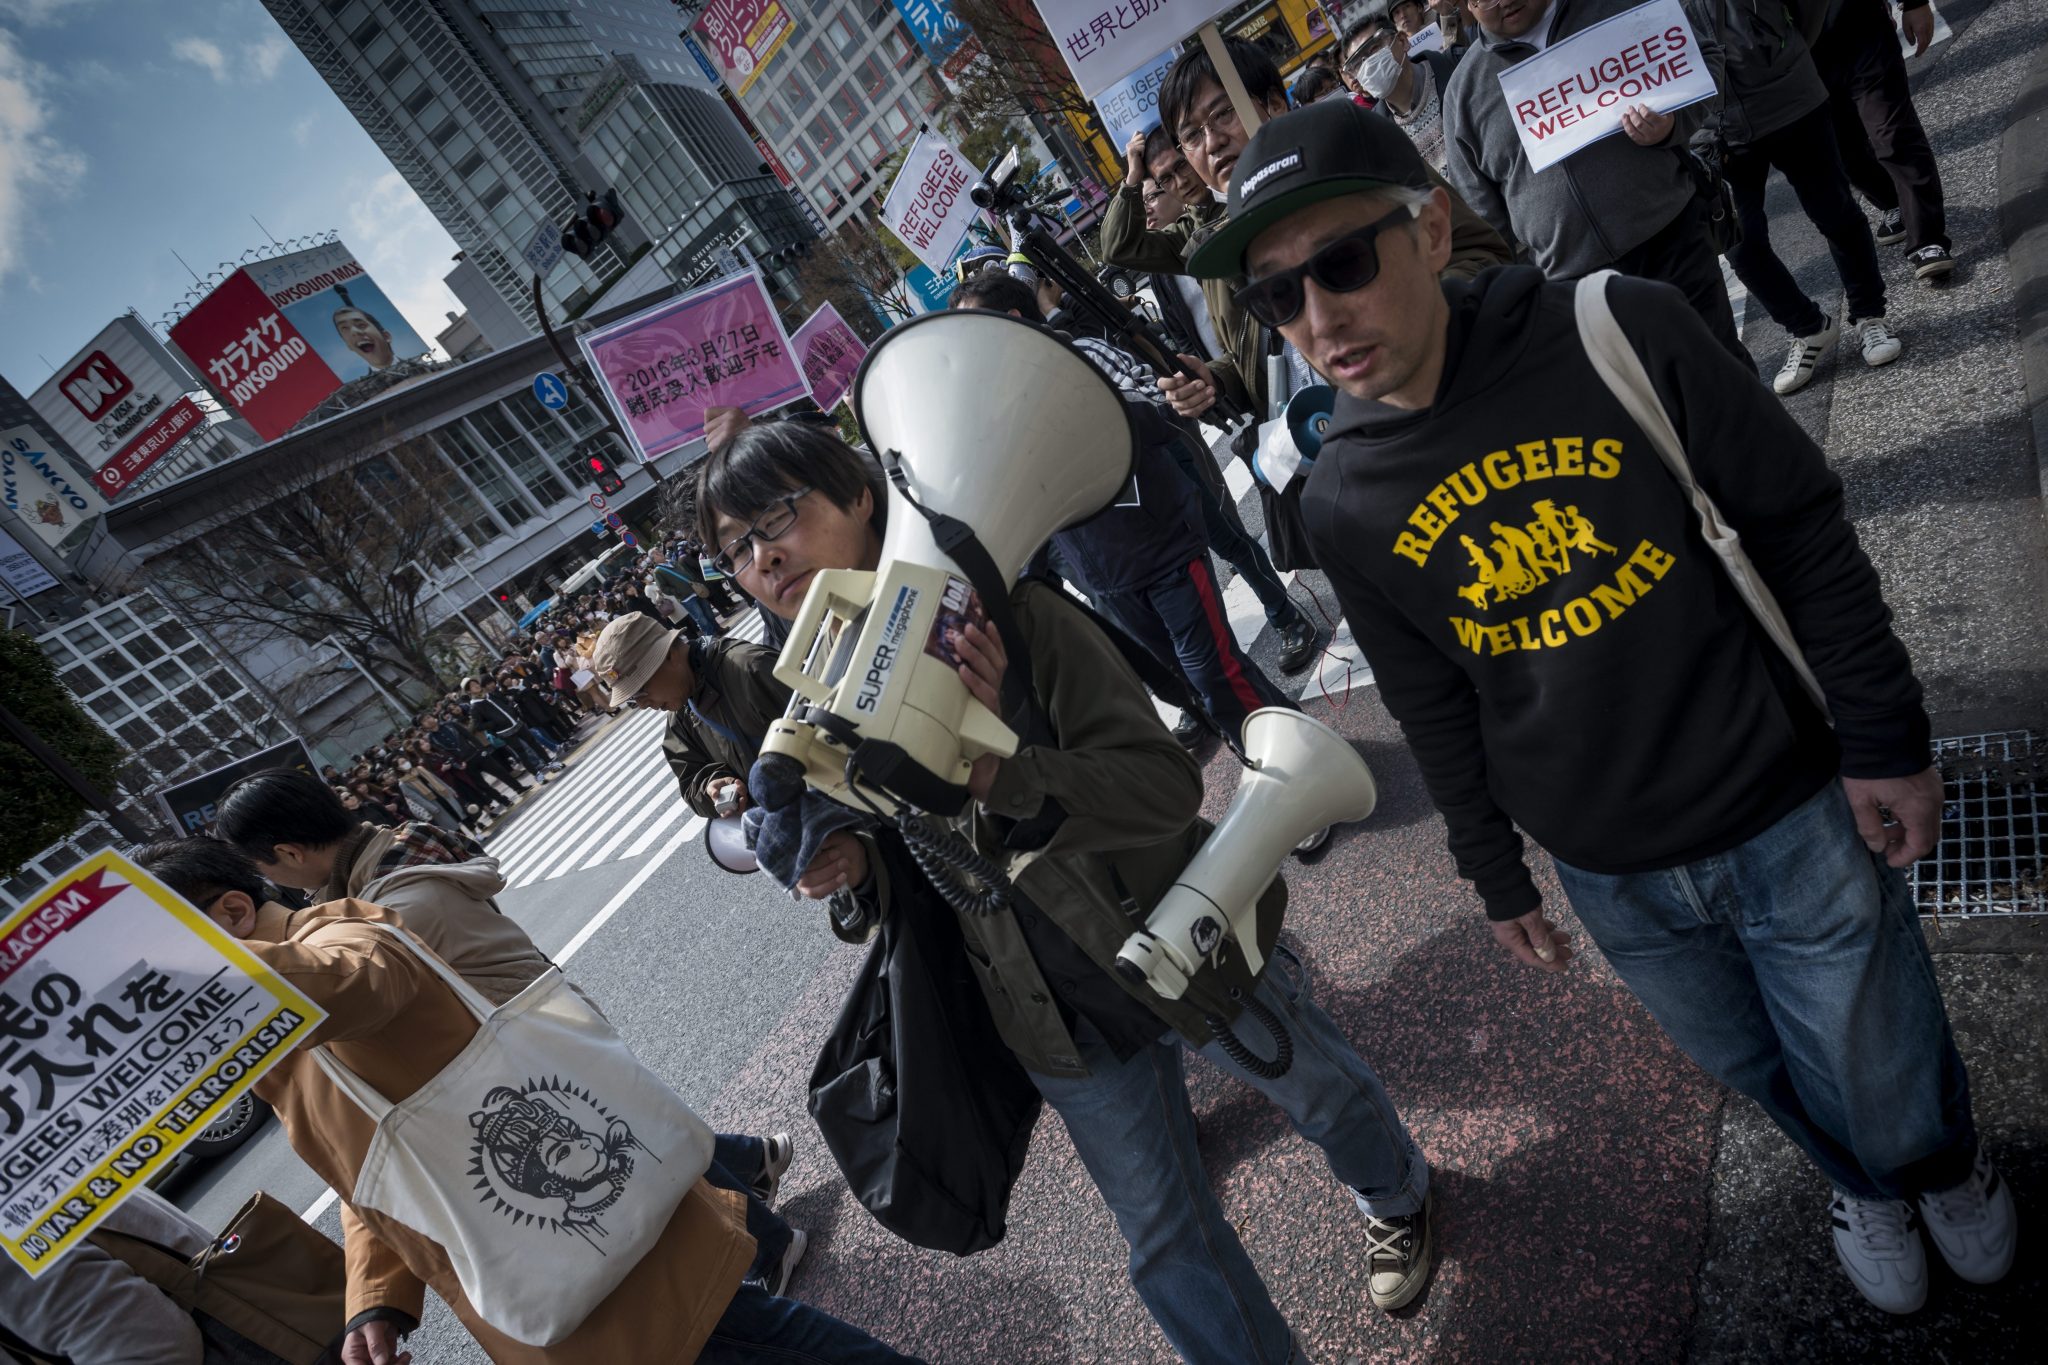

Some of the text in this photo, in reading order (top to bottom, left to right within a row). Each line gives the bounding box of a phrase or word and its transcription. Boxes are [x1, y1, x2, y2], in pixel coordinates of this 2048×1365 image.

[719, 0, 768, 57] クリニッ
[1067, 0, 1166, 63] 世界と助
[1109, 87, 1160, 132] WELCO
[1516, 26, 1688, 125] REFUGEES
[1528, 53, 1694, 141] WELCOME
[898, 149, 954, 241] REFUGEES
[912, 165, 969, 250] WELCOME
[1240, 153, 1299, 199] Nopasaran
[691, 232, 725, 263] SHIBUYA
[270, 261, 365, 308] JOYSOUND MAX
[208, 313, 282, 388] カラオケ
[229, 336, 307, 407] JOYSOUND
[625, 324, 760, 392] 2016年3月27日
[625, 339, 782, 418] 難民受入歓迎デモ
[64, 359, 124, 415] DC
[96, 391, 145, 435] DC VISA &
[98, 393, 162, 451] DC MasterCard
[122, 408, 193, 472] 三菱東京UFJ銀行
[9, 437, 88, 511] SANKYO
[1393, 437, 1624, 568] REFUGEES
[891, 588, 918, 645] megaphone
[1449, 539, 1677, 656] WELCOME
[856, 645, 896, 713] SUPER
[0, 889, 91, 971] RACISM
[79, 981, 236, 1110] WELCOME
[20, 1008, 305, 1261] NO WAR & NO TERRORISM
